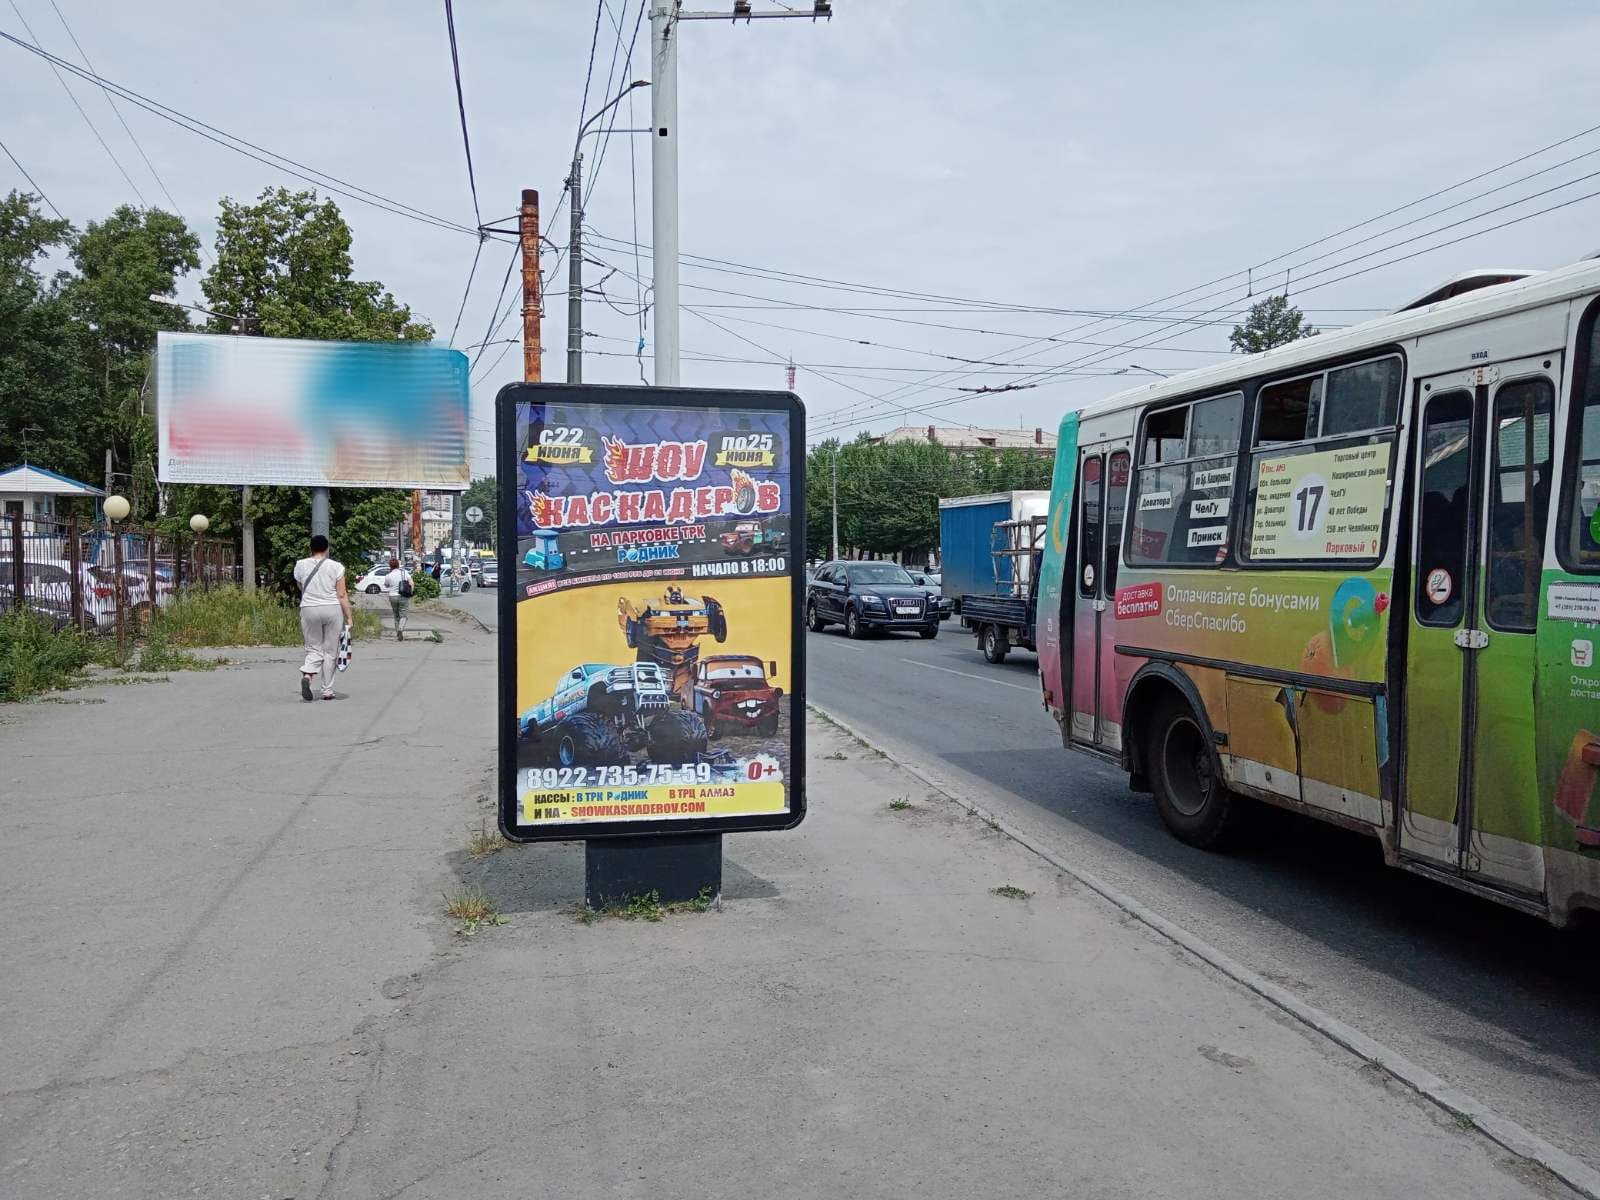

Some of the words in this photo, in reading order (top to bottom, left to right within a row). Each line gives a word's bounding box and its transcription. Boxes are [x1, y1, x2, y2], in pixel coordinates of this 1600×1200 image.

[538, 446, 580, 459] ИЮНЯ
[606, 438, 708, 484] ШОУ
[726, 451, 763, 463] ИЮНЯ
[534, 479, 781, 529] КАСКАДЕРОВ
[1297, 486, 1324, 531] 17
[591, 533, 610, 547] НА
[612, 526, 679, 545] ПАРКОВКЕ
[681, 525, 706, 539] ТРК
[617, 544, 680, 563] РОДНИК
[1325, 541, 1366, 556] Парковый
[692, 562, 739, 577] НАЧАЛО
[741, 561, 749, 574] В
[751, 557, 786, 573] 18:00
[1123, 587, 1153, 602] доставка
[1167, 585, 1246, 607] Оплачивайте
[1249, 587, 1320, 613] бонусами
[1117, 600, 1159, 616] бесплатно
[1166, 608, 1247, 633] СберСпасибо
[527, 762, 711, 789] 8922-735-75-59
[748, 761, 777, 780] 0+
[576, 792, 583, 802] В
[585, 791, 602, 802] ТРК
[669, 789, 676, 799] В
[678, 788, 696, 799] ТРЦ
[700, 787, 735, 798] АЛМАЗ
[534, 809, 541, 819] И
[545, 808, 560, 819] НА
[571, 802, 705, 817] SHOWKASKADEROV.COM
